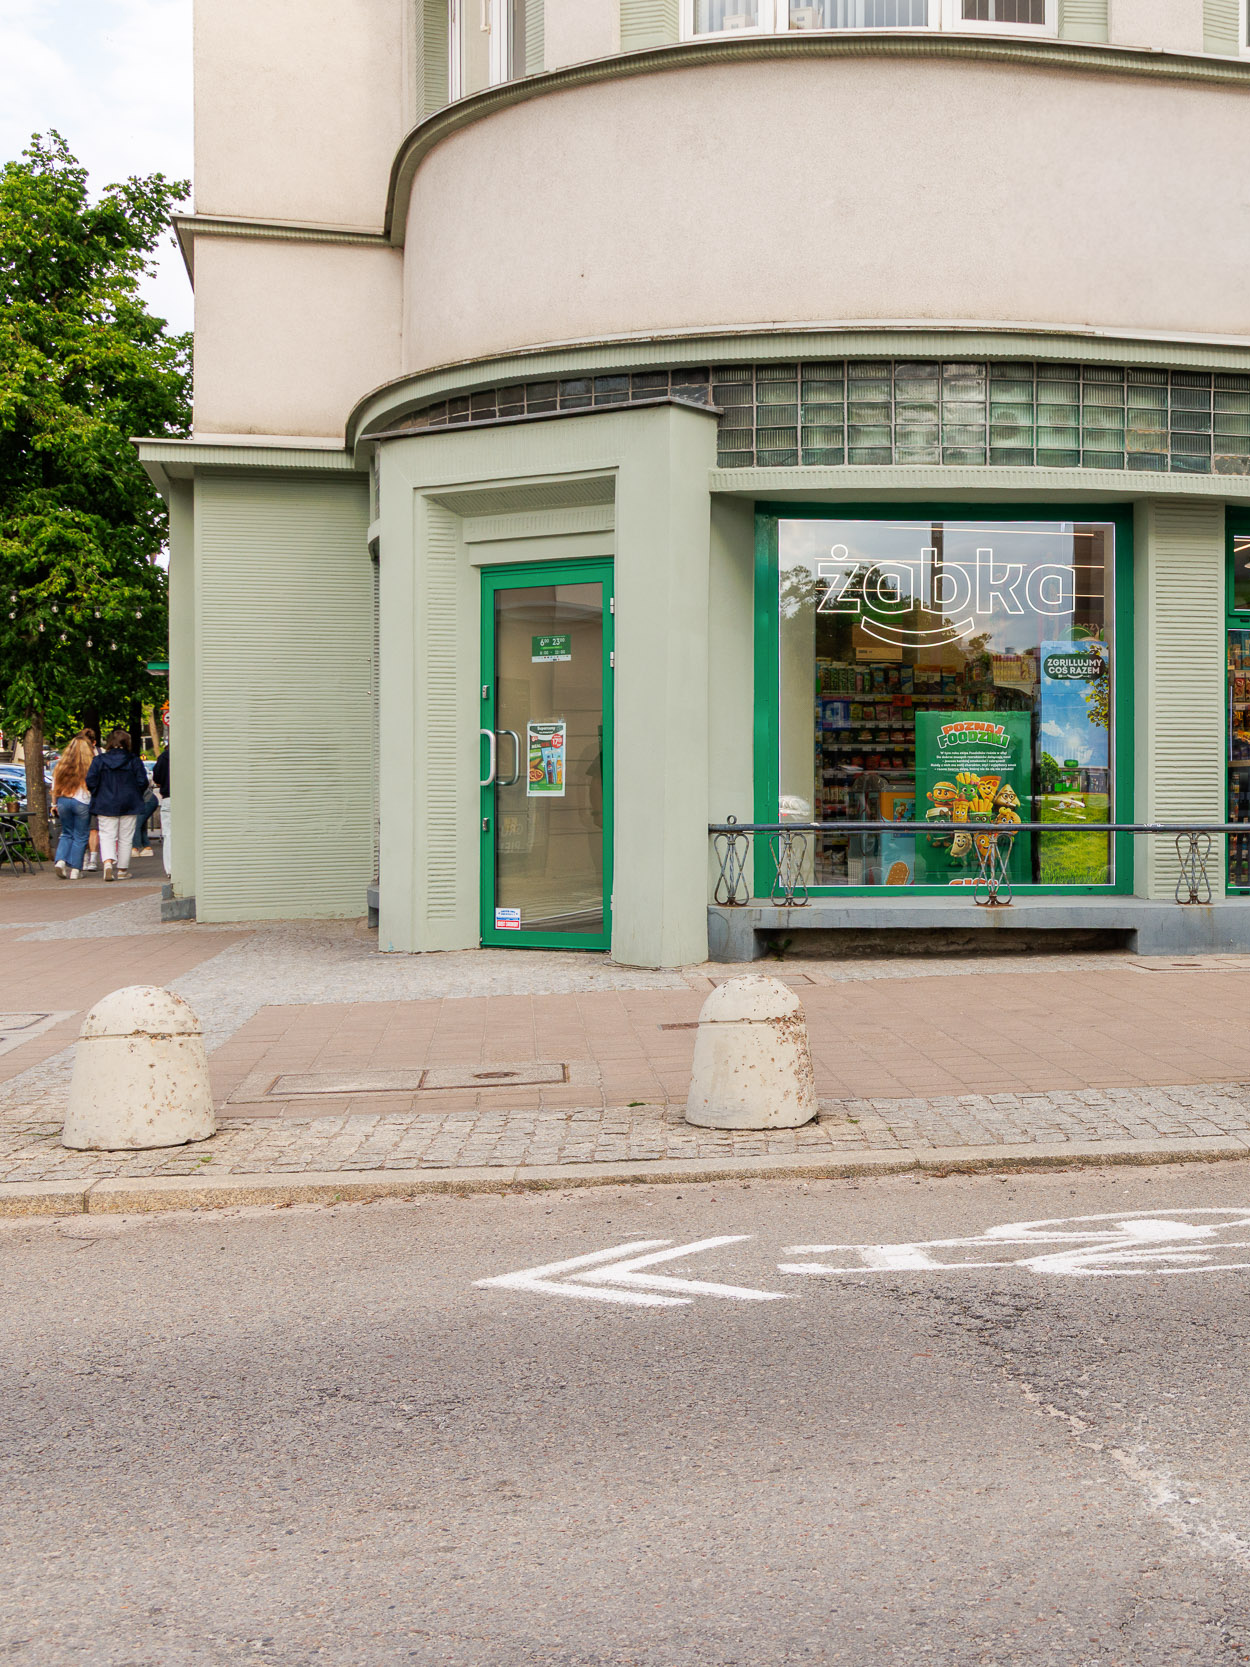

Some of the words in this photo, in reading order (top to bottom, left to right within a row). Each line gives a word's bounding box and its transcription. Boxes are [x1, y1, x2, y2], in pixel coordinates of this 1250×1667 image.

[816, 543, 1076, 616] żabka
[1047, 658, 1102, 667] ZGRILLUJMY
[1048, 665, 1068, 674] COŚ
[1070, 666, 1100, 674] RAZEM
[941, 721, 1005, 735] POZNAJ
[937, 731, 1010, 749] FOODZIKI
